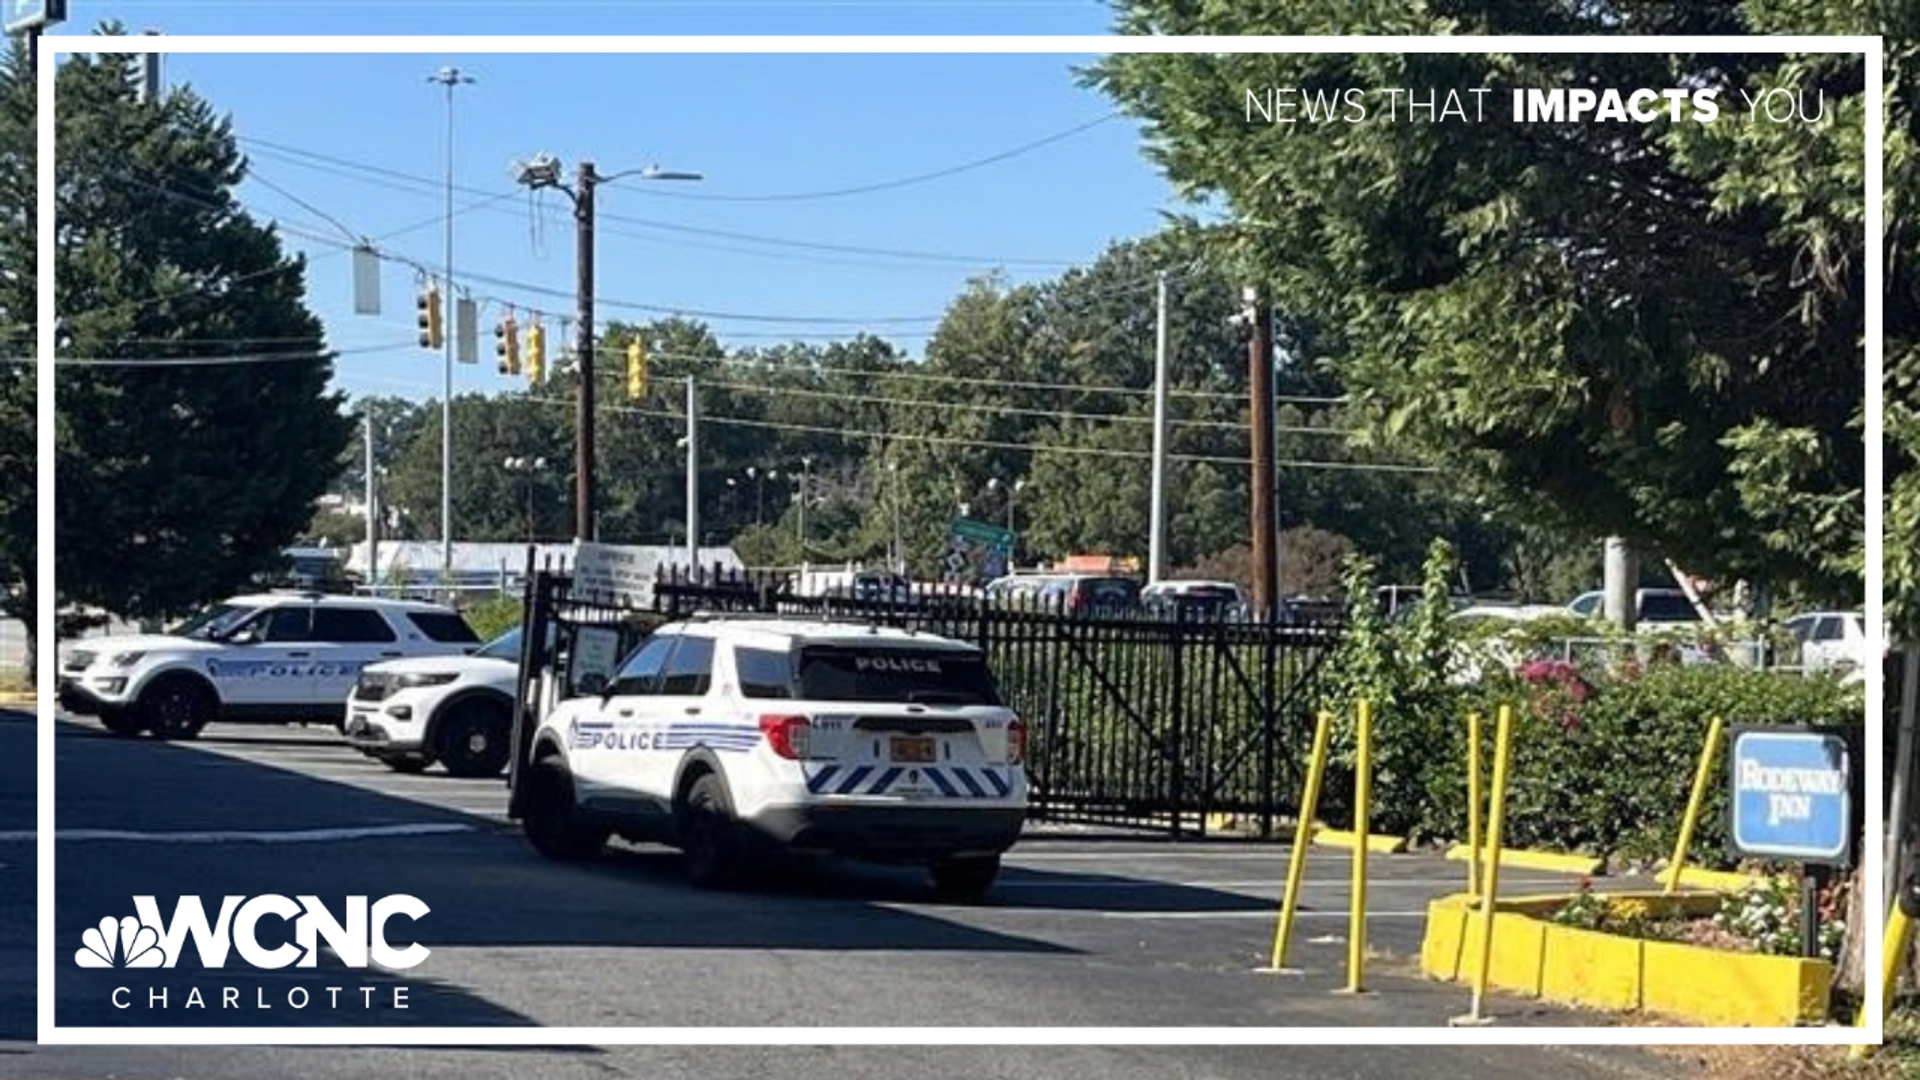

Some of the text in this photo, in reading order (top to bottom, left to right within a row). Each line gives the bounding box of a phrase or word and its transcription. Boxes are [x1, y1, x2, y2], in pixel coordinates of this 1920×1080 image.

[250, 663, 354, 677] POLICE
[854, 657, 941, 673] POLICE
[592, 732, 664, 750] POLICE
[1738, 758, 1843, 794] RODEWAY
[1767, 794, 1812, 826] INN
